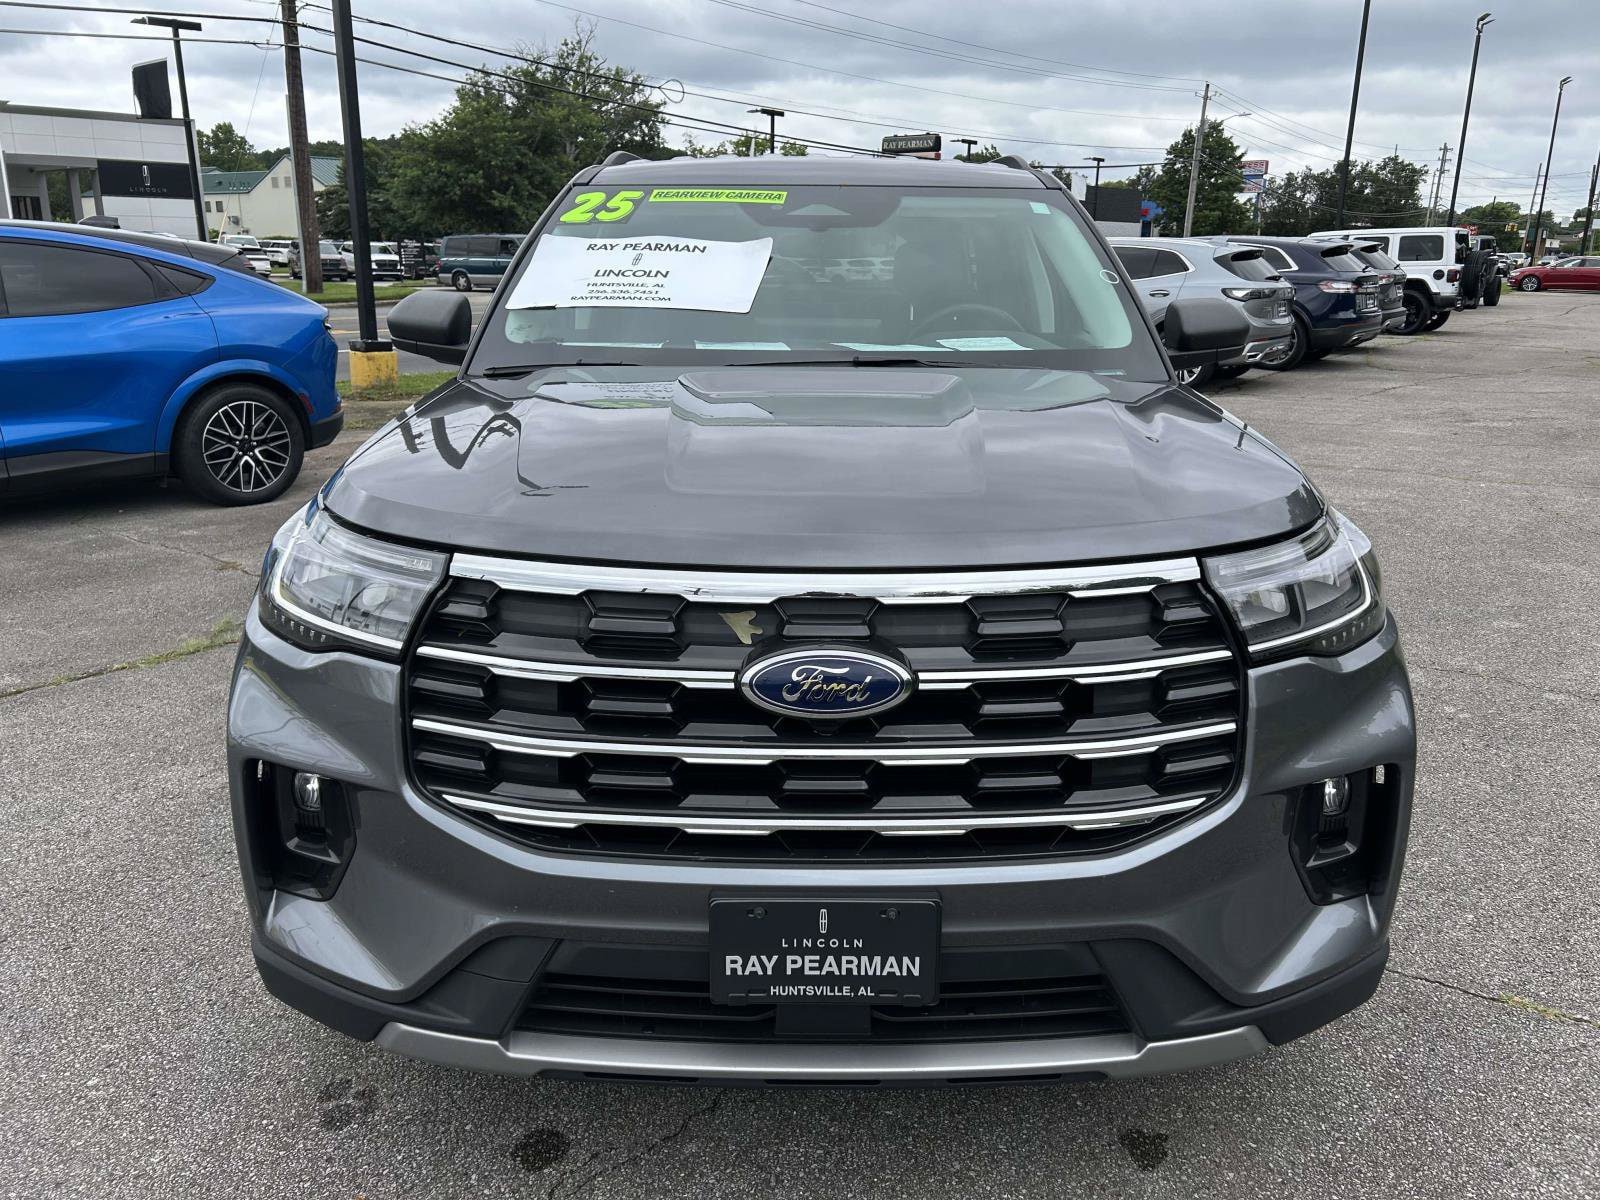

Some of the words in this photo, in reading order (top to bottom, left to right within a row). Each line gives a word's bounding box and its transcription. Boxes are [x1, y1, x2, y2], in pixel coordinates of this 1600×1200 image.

[883, 141, 898, 149] RAY
[898, 139, 933, 149] PEARMAN
[652, 189, 724, 200] REARVIEW
[725, 190, 784, 201] CAMERA
[559, 190, 645, 224] 25
[586, 243, 620, 251] RAY
[622, 242, 707, 254] PEARMAN
[594, 269, 670, 279] LINCOLN
[782, 665, 873, 702] Ford
[782, 938, 864, 948] LINCOLN
[725, 955, 779, 976] RAY
[786, 955, 920, 977] PEARMAN
[770, 985, 854, 998] HUNTSVILLE,
[858, 986, 875, 996] AL
